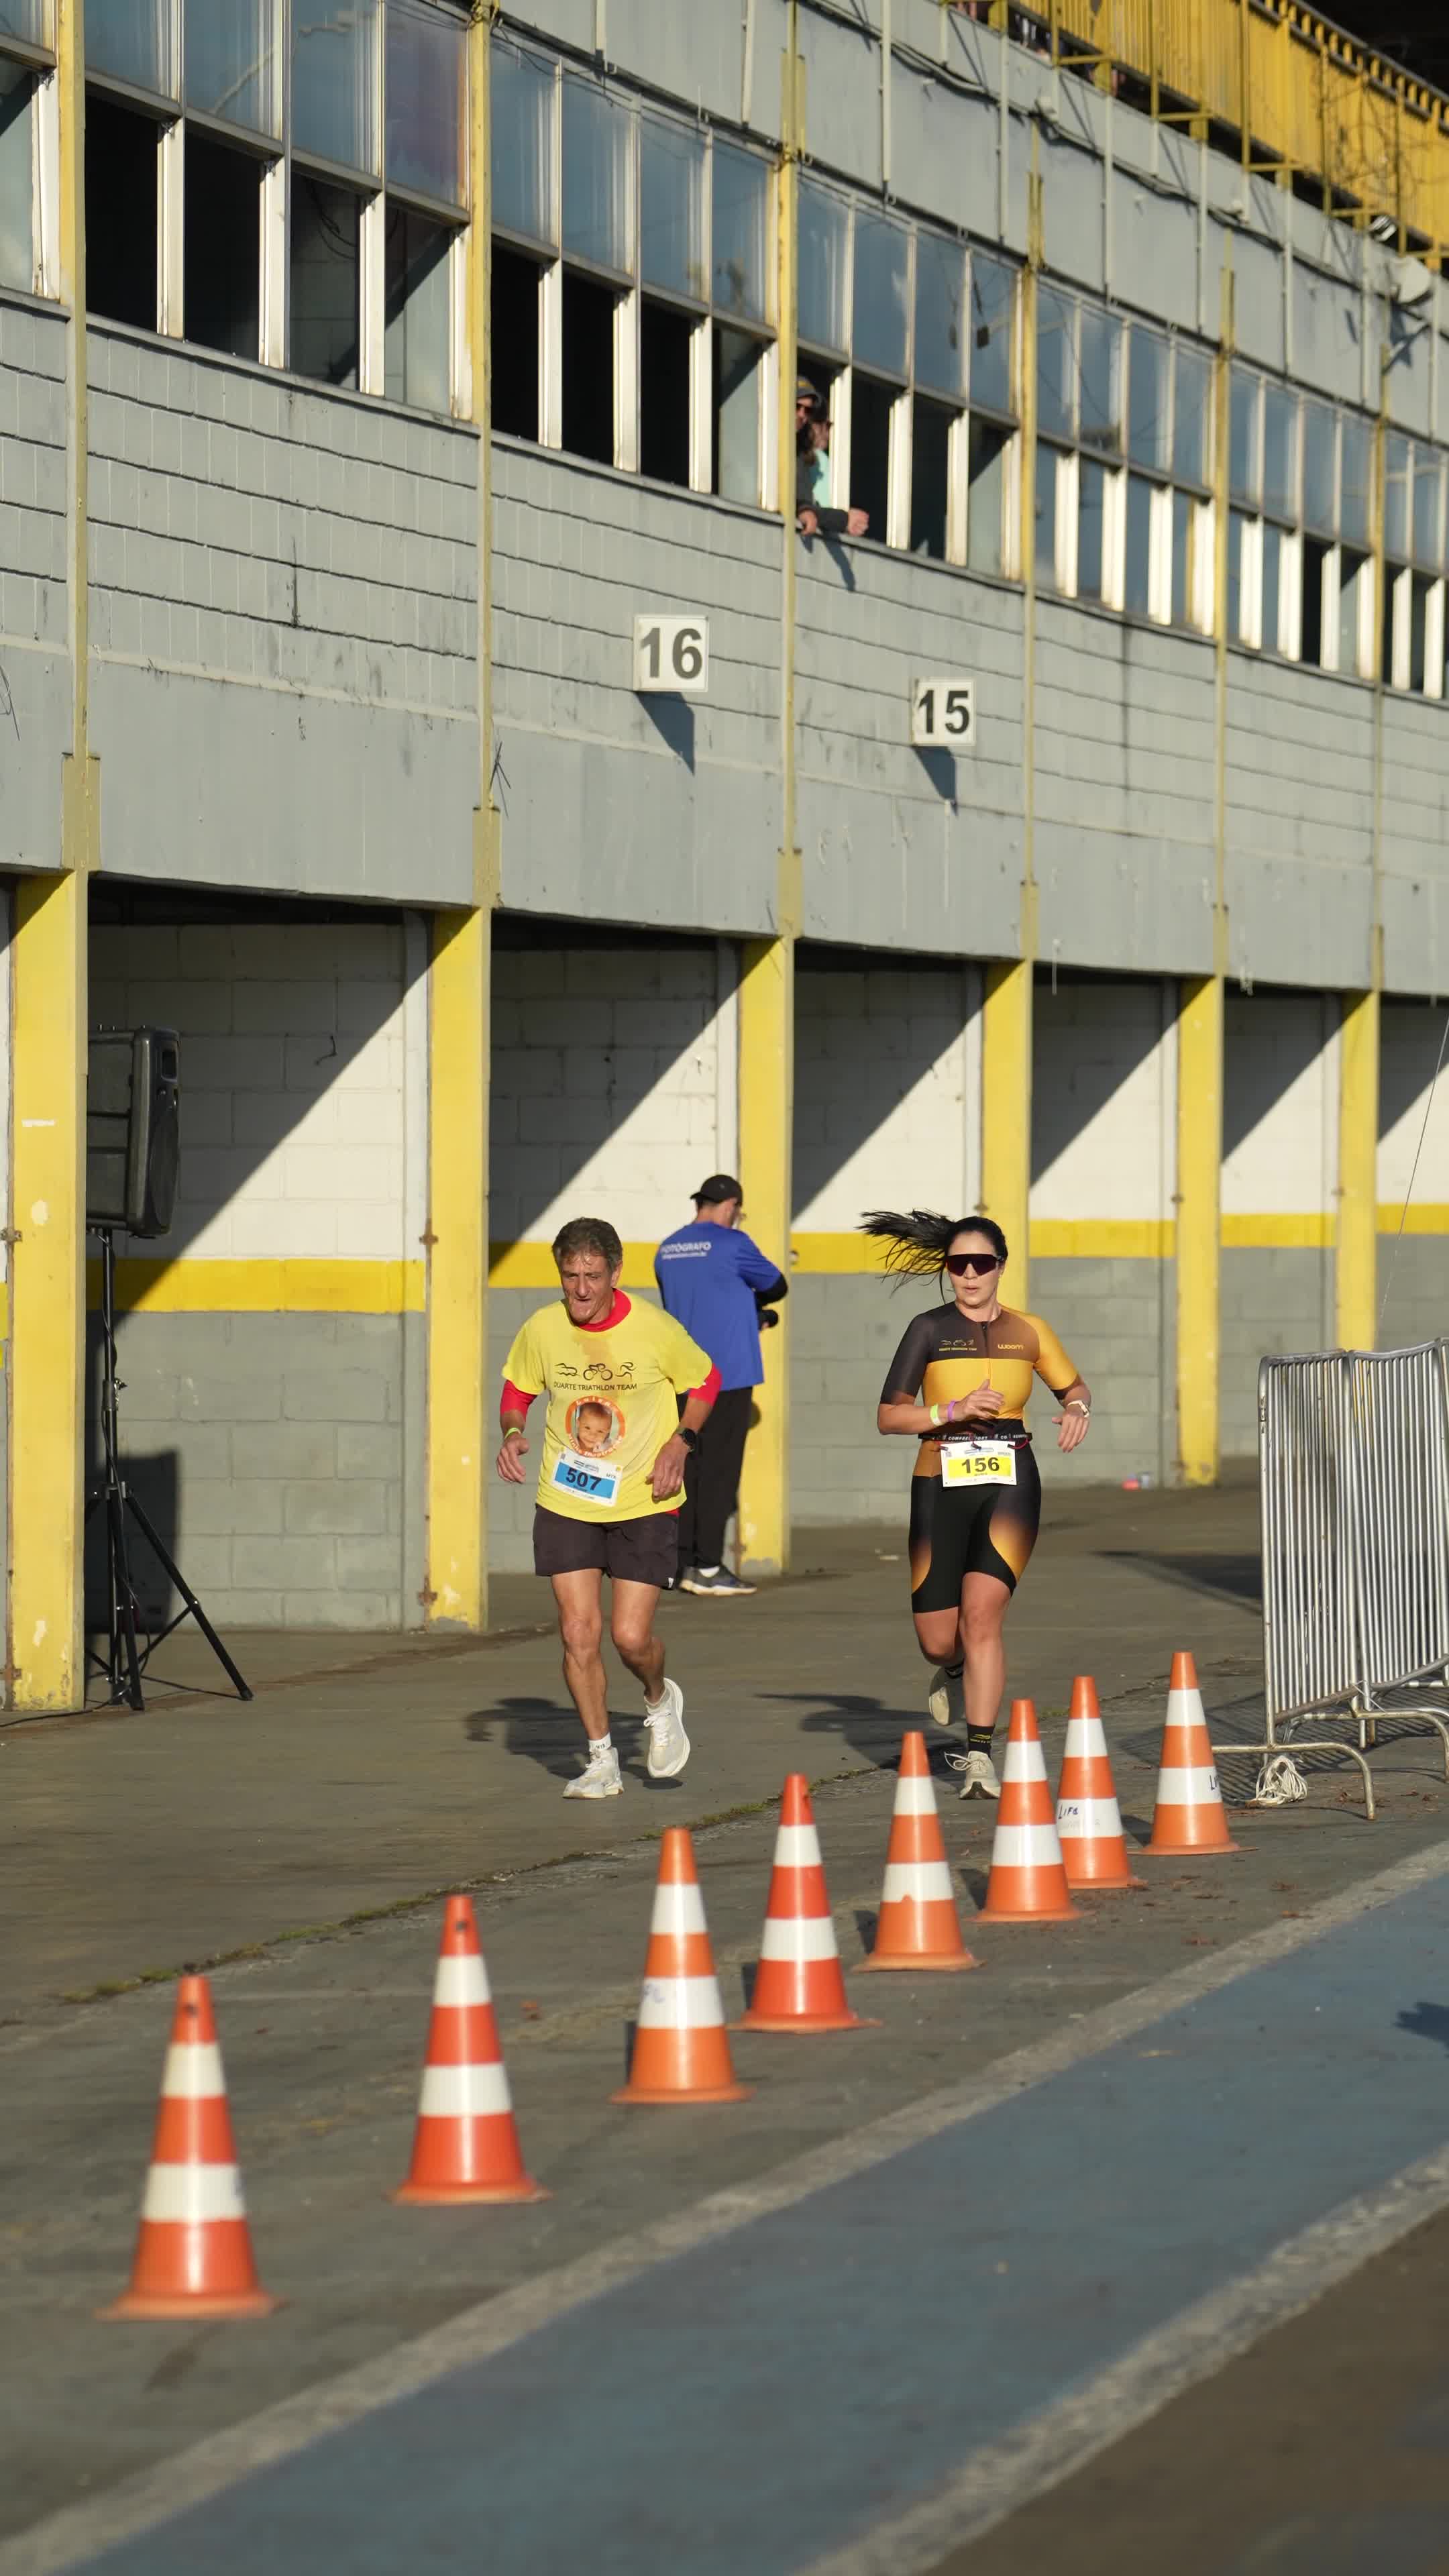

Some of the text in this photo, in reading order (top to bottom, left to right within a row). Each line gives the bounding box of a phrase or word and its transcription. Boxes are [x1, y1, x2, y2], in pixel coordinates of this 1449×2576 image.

[639, 627, 704, 680] 16
[917, 689, 970, 735] 15
[553, 1381, 577, 1391] DUARTE
[961, 1456, 1000, 1474] 156
[566, 1466, 602, 1491] 507
